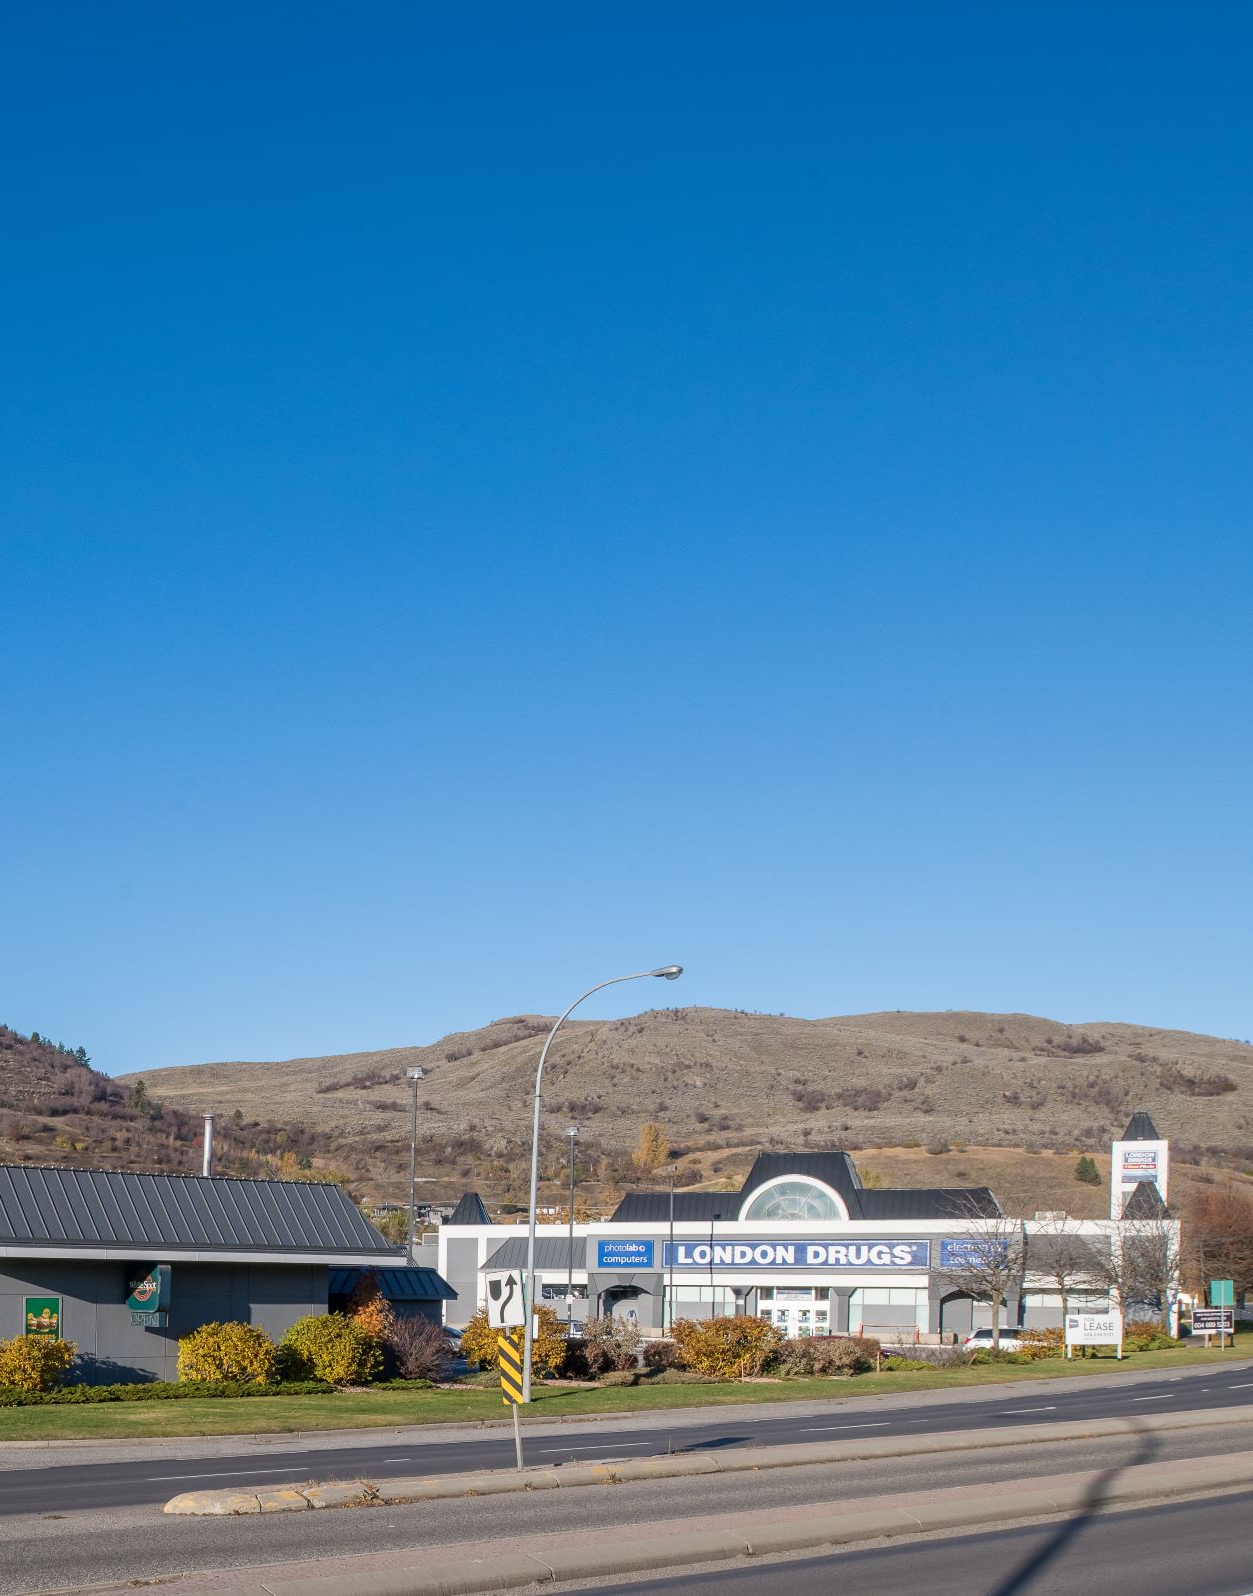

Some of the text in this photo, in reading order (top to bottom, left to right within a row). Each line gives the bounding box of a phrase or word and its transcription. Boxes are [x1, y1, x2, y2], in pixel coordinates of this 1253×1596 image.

[604, 1243, 639, 1253] photolab
[603, 1255, 648, 1265] computers
[677, 1245, 794, 1265] LONDON
[1083, 1322, 1114, 1331] LEASE
